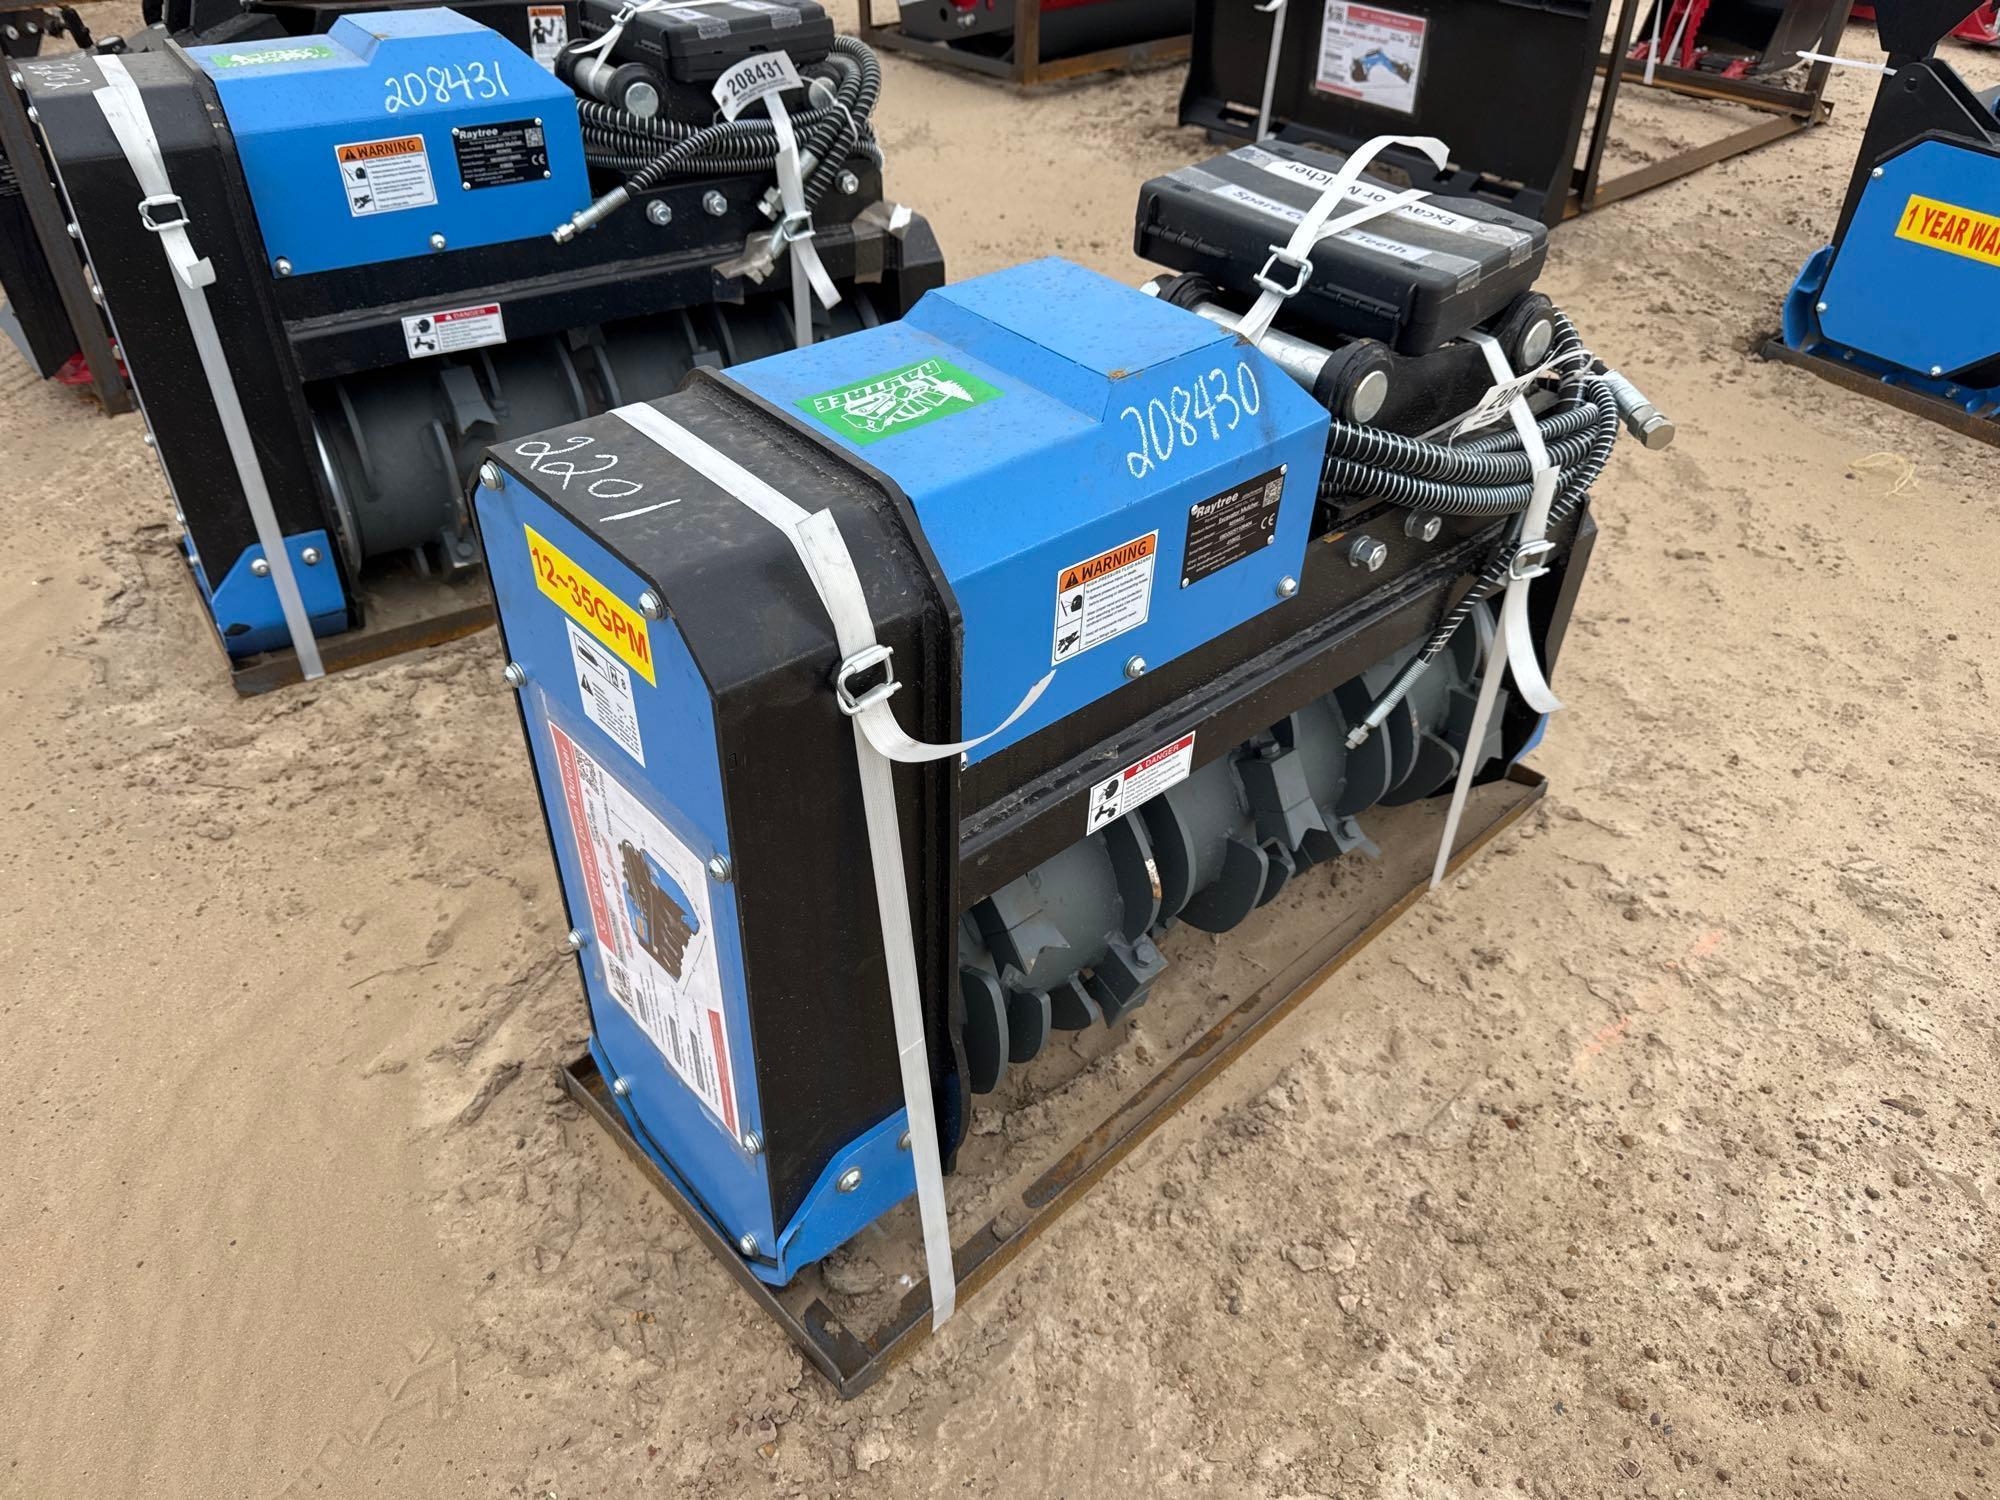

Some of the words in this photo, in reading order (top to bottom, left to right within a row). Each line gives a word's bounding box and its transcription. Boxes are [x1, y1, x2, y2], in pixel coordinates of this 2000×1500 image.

[385, 60, 510, 113] 208431
[726, 59, 785, 96] 208431
[357, 140, 416, 158] WARNING
[459, 128, 498, 140] Raytree
[1232, 190, 1284, 214] Spare
[1358, 234, 1408, 254] Teeth
[1907, 204, 1920, 231] 1
[1920, 207, 1970, 246] YEAR
[1968, 221, 2000, 257] WA
[1120, 361, 1260, 479] 208430
[516, 437, 682, 522] 2201
[1195, 492, 1239, 519] Raytree
[1082, 540, 1147, 581] WARNING
[532, 548, 649, 664] 12~35GPM
[561, 746, 577, 801] Mulcher
[1145, 744, 1179, 767] DANGER
[574, 805, 586, 841] Drum
[583, 843, 602, 908] Excavator
